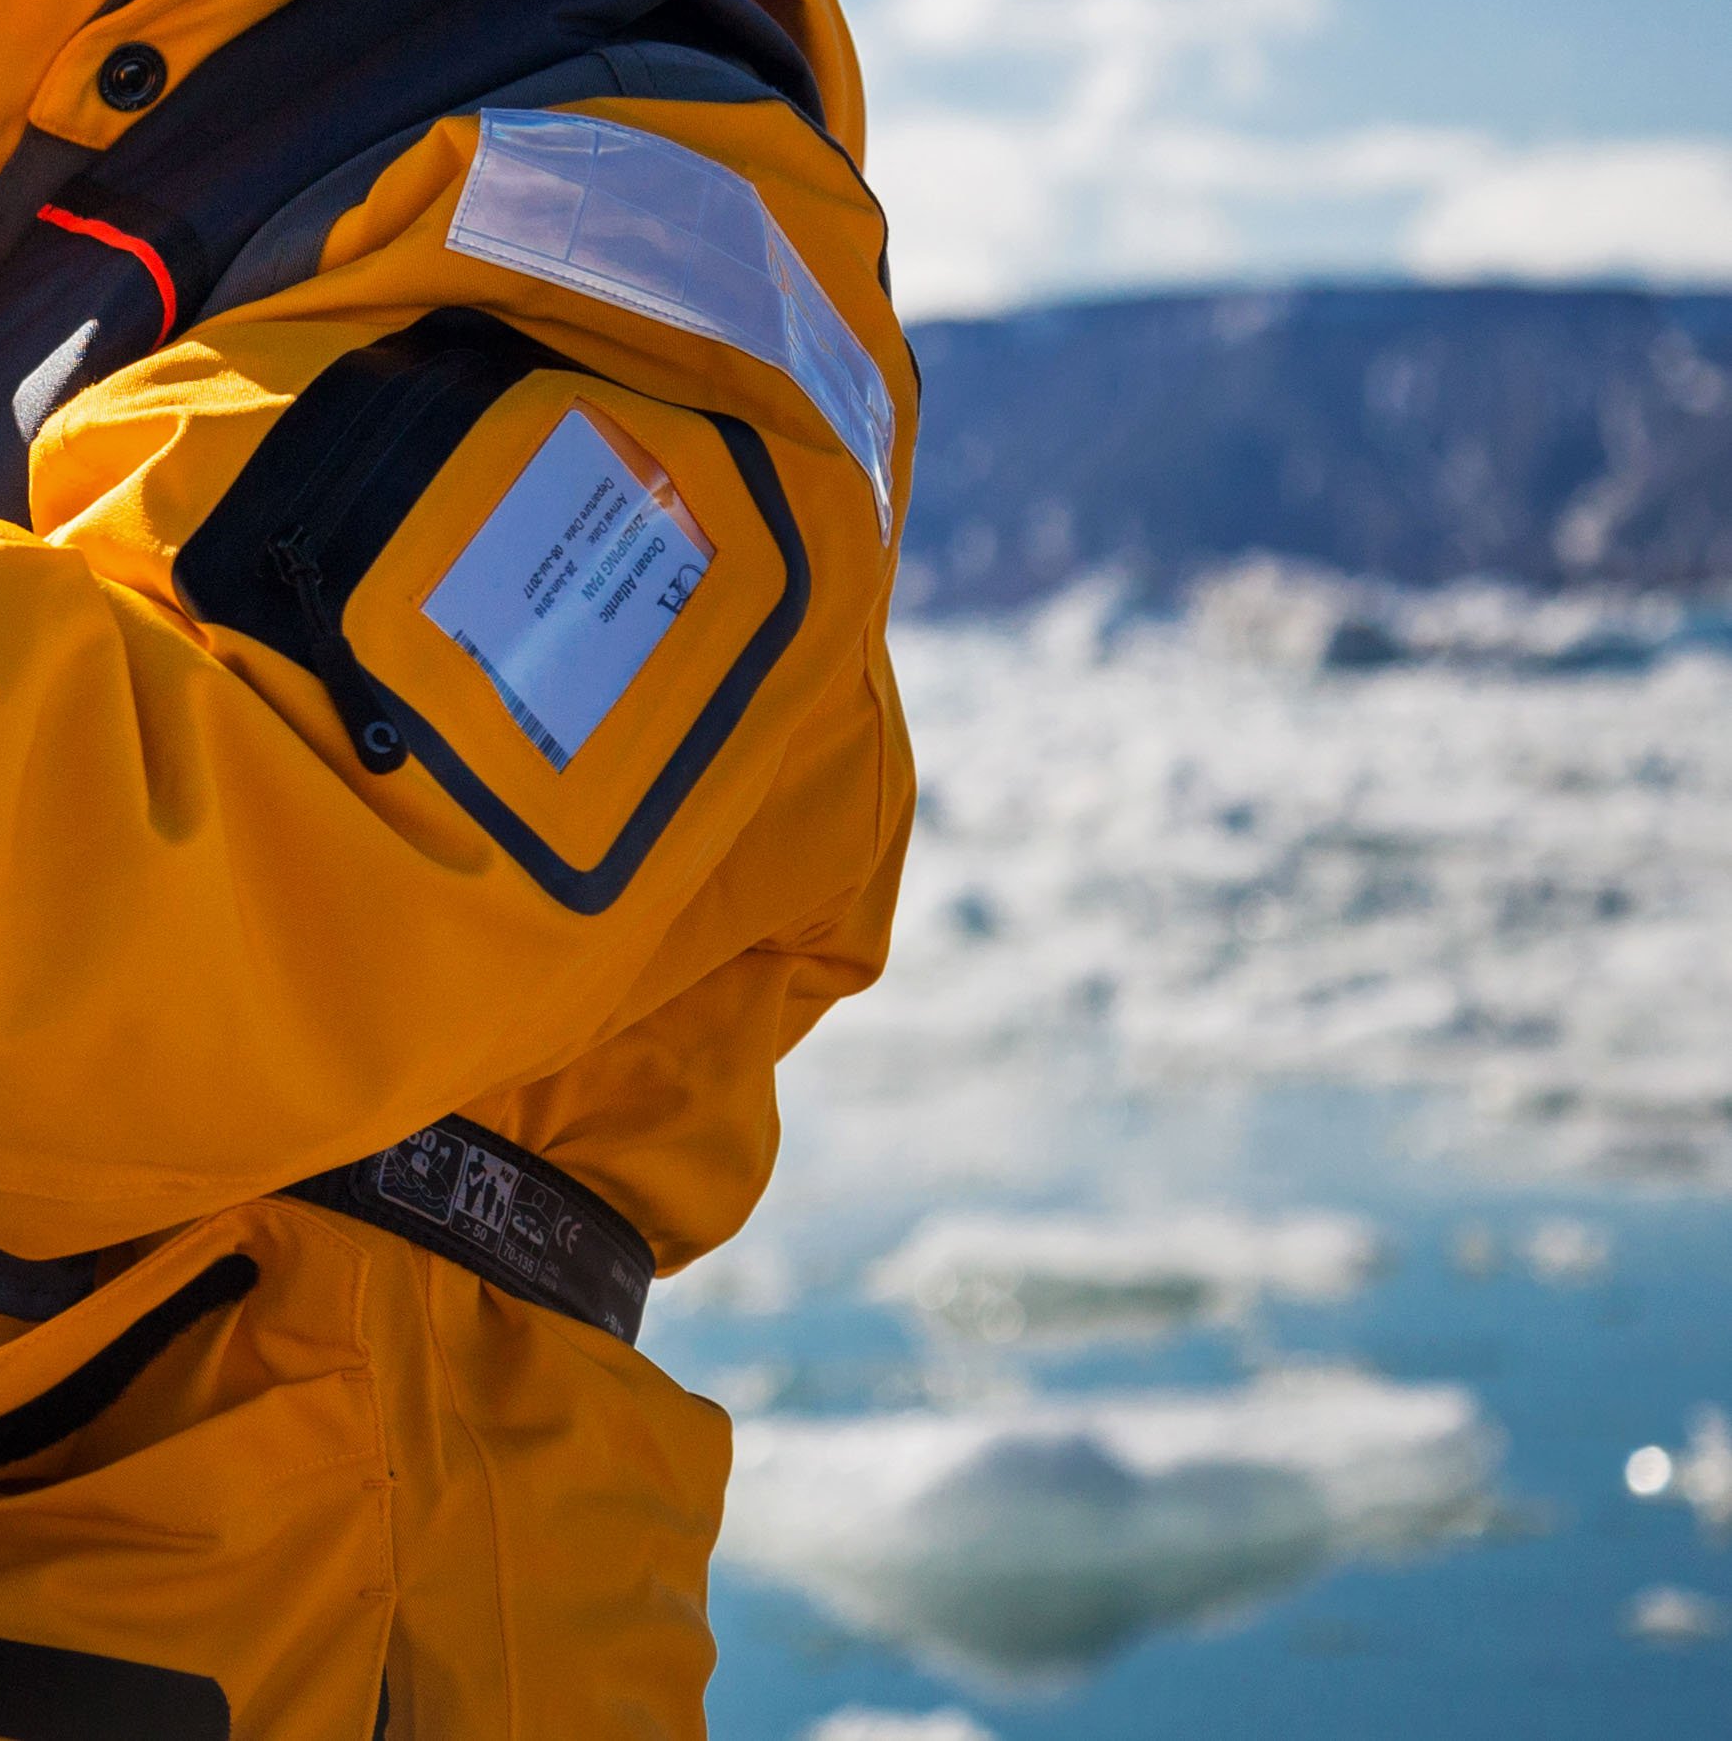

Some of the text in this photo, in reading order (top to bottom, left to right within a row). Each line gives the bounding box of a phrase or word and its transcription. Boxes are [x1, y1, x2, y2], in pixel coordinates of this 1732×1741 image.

[581, 476, 615, 521] Departure
[602, 492, 628, 527] Arrival
[565, 518, 585, 543] Date:
[586, 520, 609, 547] Date:
[581, 513, 648, 602] ZHENPING PAN
[599, 536, 666, 624] Ocean Atlantic
[472, 1224, 487, 1242] 50
[502, 1241, 535, 1274] 70-135
